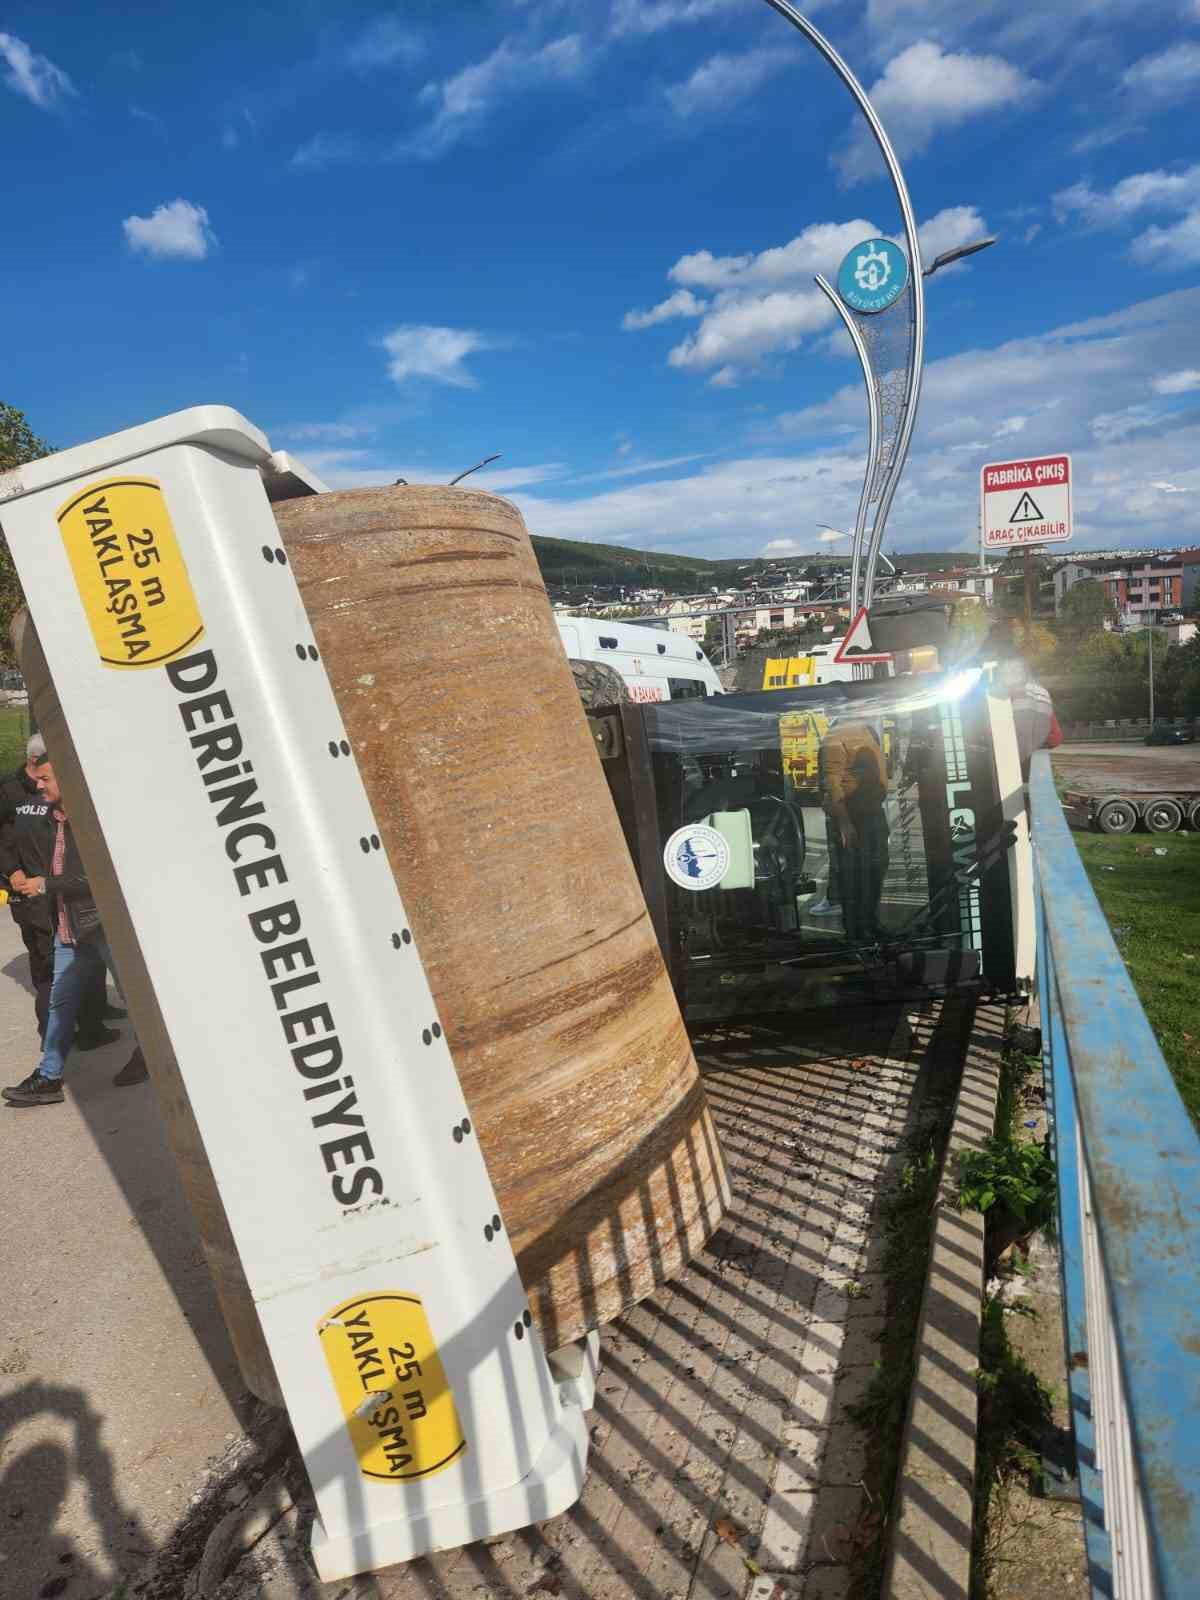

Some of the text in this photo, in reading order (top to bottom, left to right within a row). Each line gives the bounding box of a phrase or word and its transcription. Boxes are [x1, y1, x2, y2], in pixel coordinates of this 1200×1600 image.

[987, 463, 1065, 485] FABRİKA ÇIKIŞ
[126, 528, 166, 607] 25 m
[989, 528, 1014, 541] ARAÇ
[82, 496, 152, 660] YAKLAŞMA
[388, 1342, 428, 1421] 25 m
